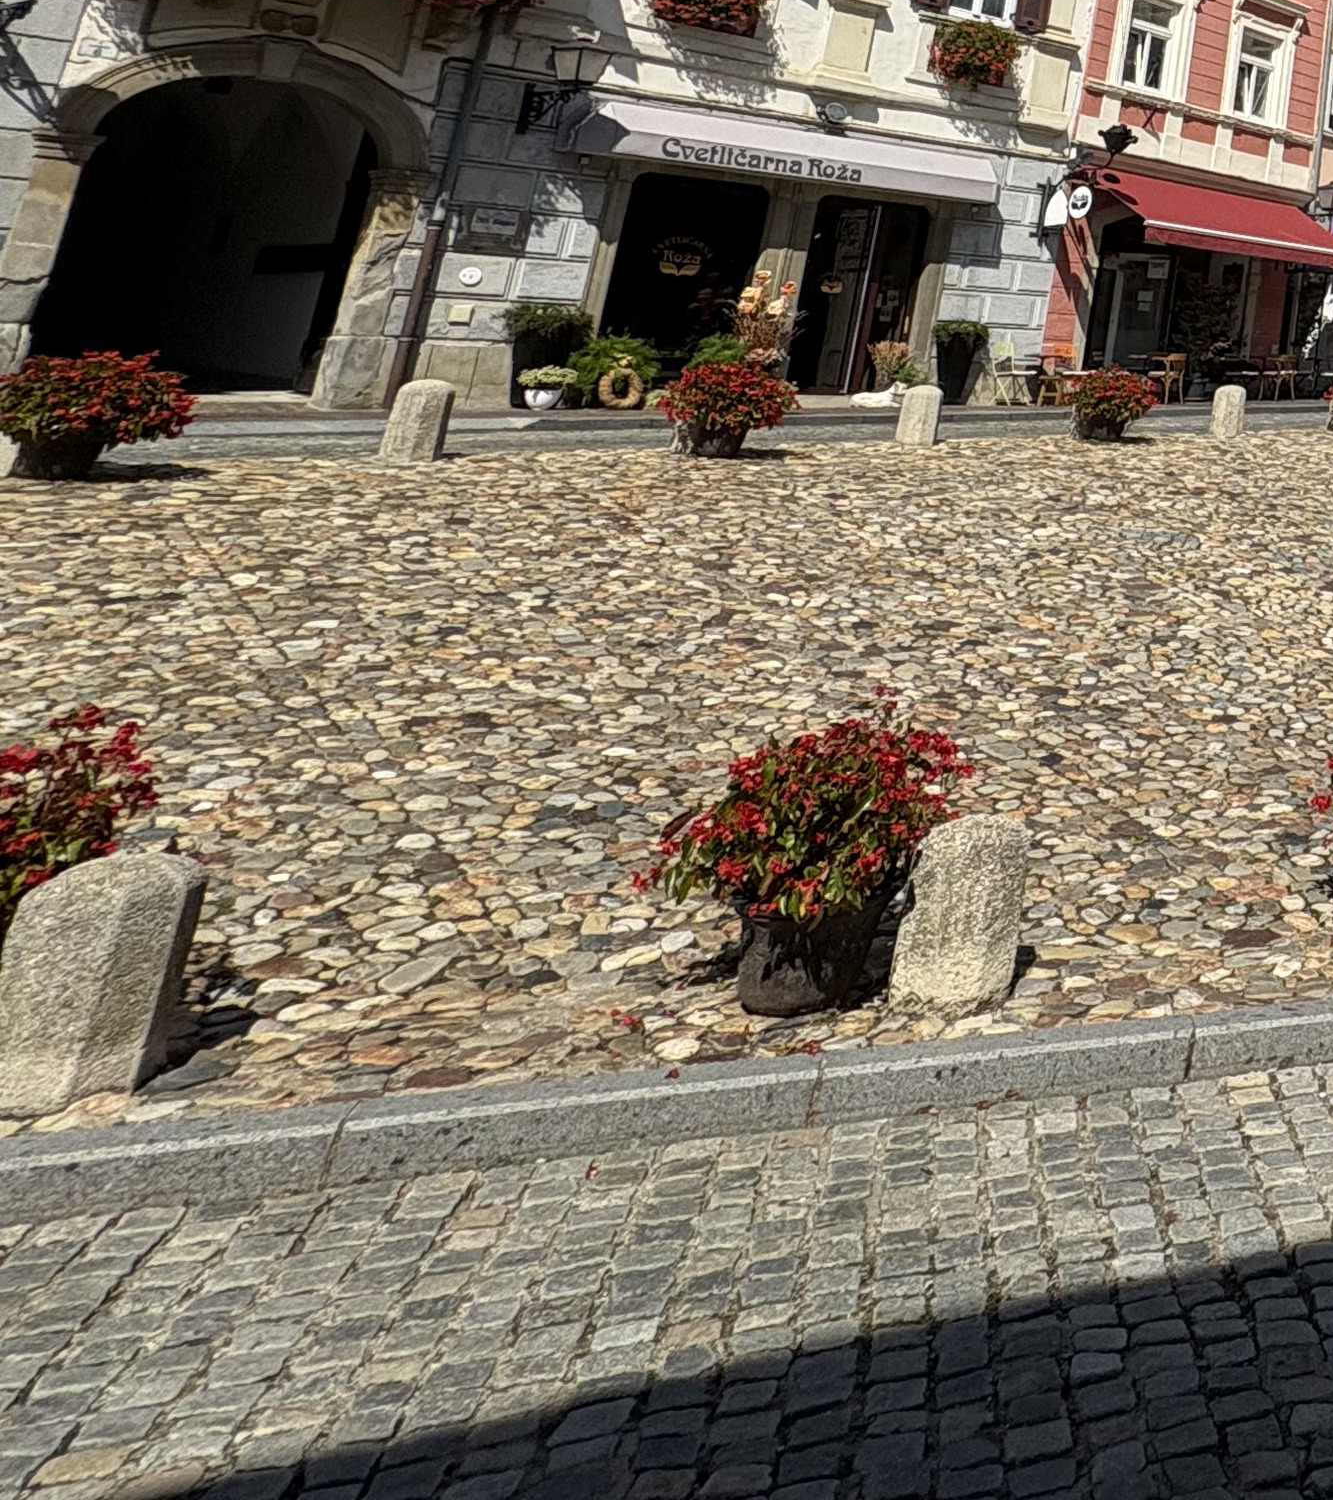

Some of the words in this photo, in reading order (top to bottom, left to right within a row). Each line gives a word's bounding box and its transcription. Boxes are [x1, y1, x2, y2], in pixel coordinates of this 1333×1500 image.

[661, 137, 803, 175] Cvetličarna
[808, 158, 863, 183] Roža
[662, 249, 702, 265] Roža
